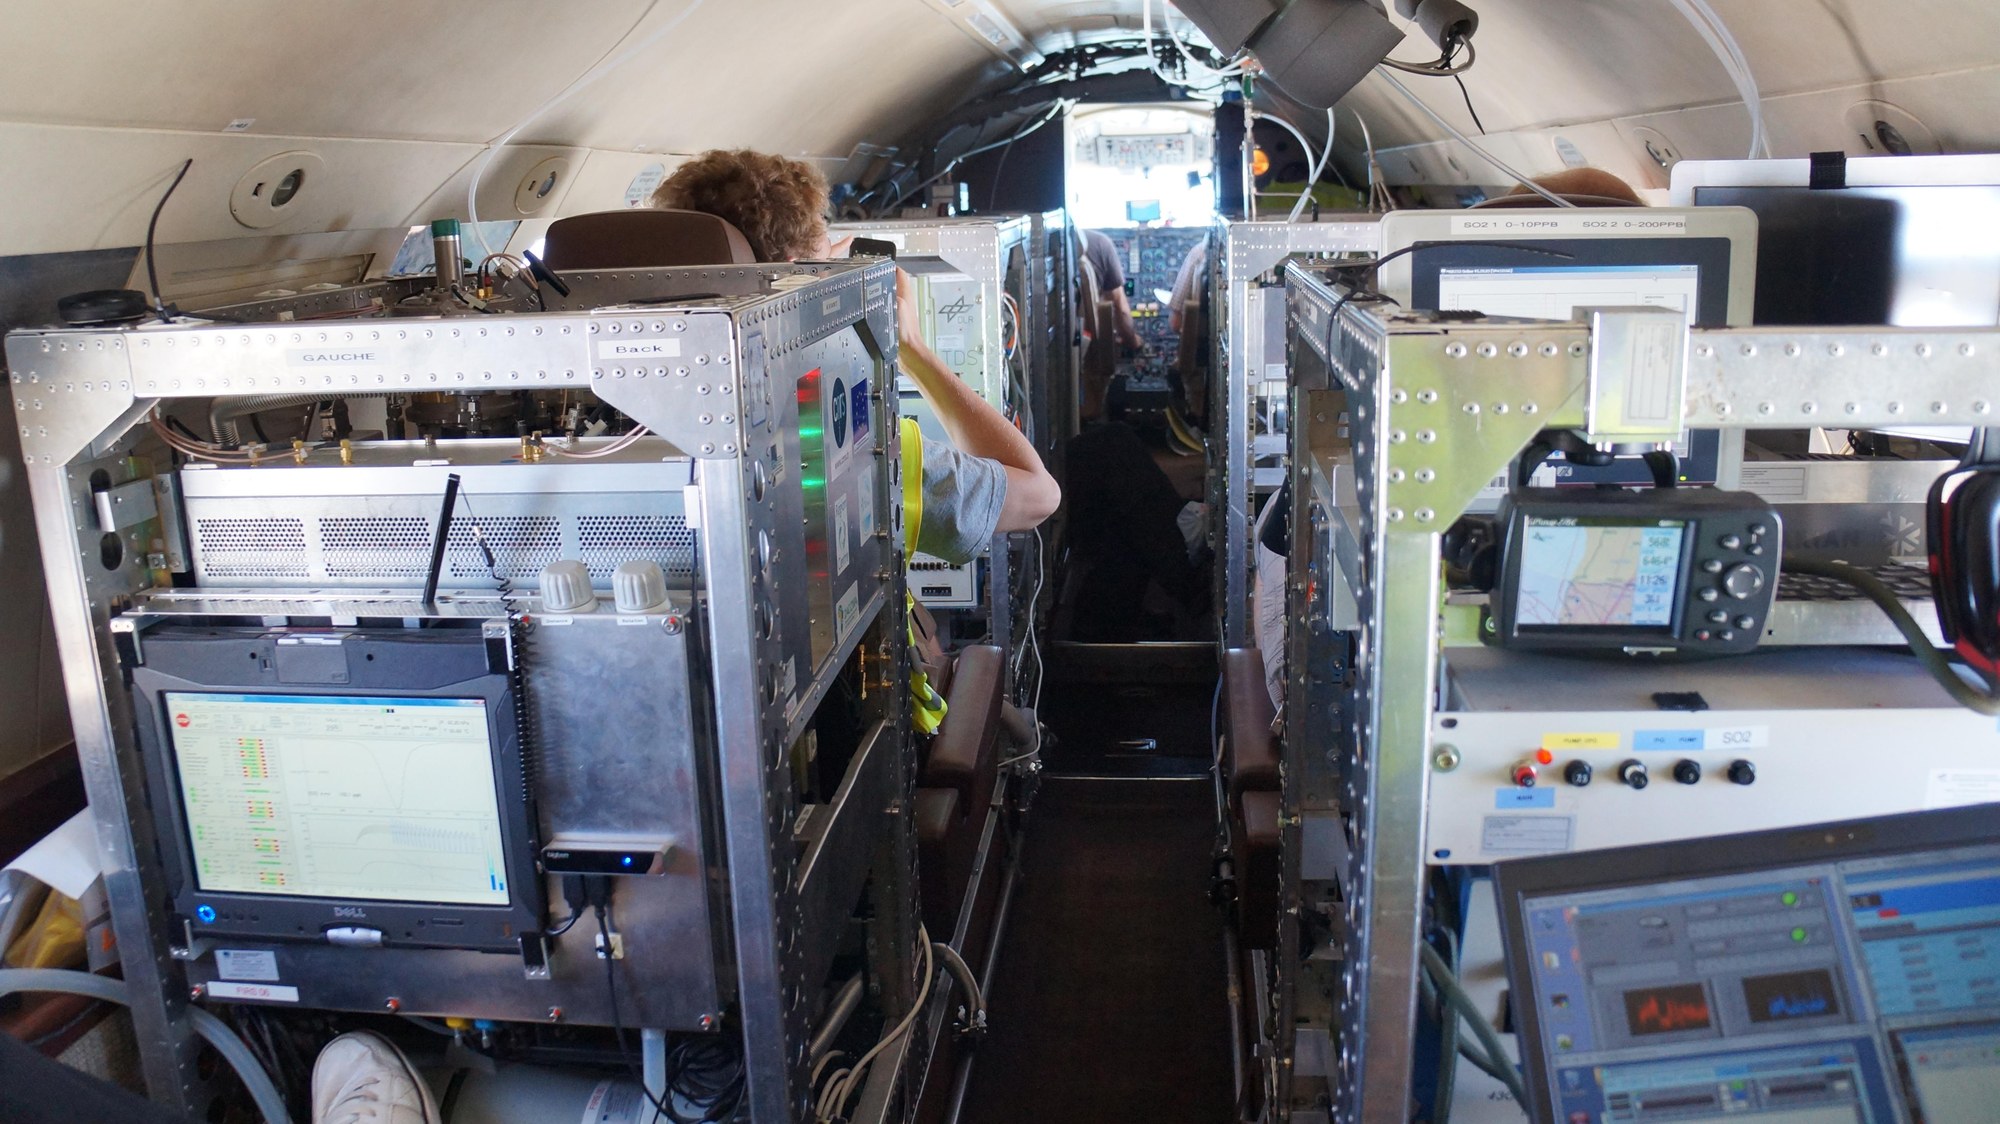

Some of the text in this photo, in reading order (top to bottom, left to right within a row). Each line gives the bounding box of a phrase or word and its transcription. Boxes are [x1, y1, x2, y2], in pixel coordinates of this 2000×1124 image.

[616, 345, 663, 354] Back
[302, 353, 375, 362] GAUCHE
[942, 349, 978, 366] TDS
[1723, 731, 1752, 744] SO2
[333, 906, 367, 919] DELL
